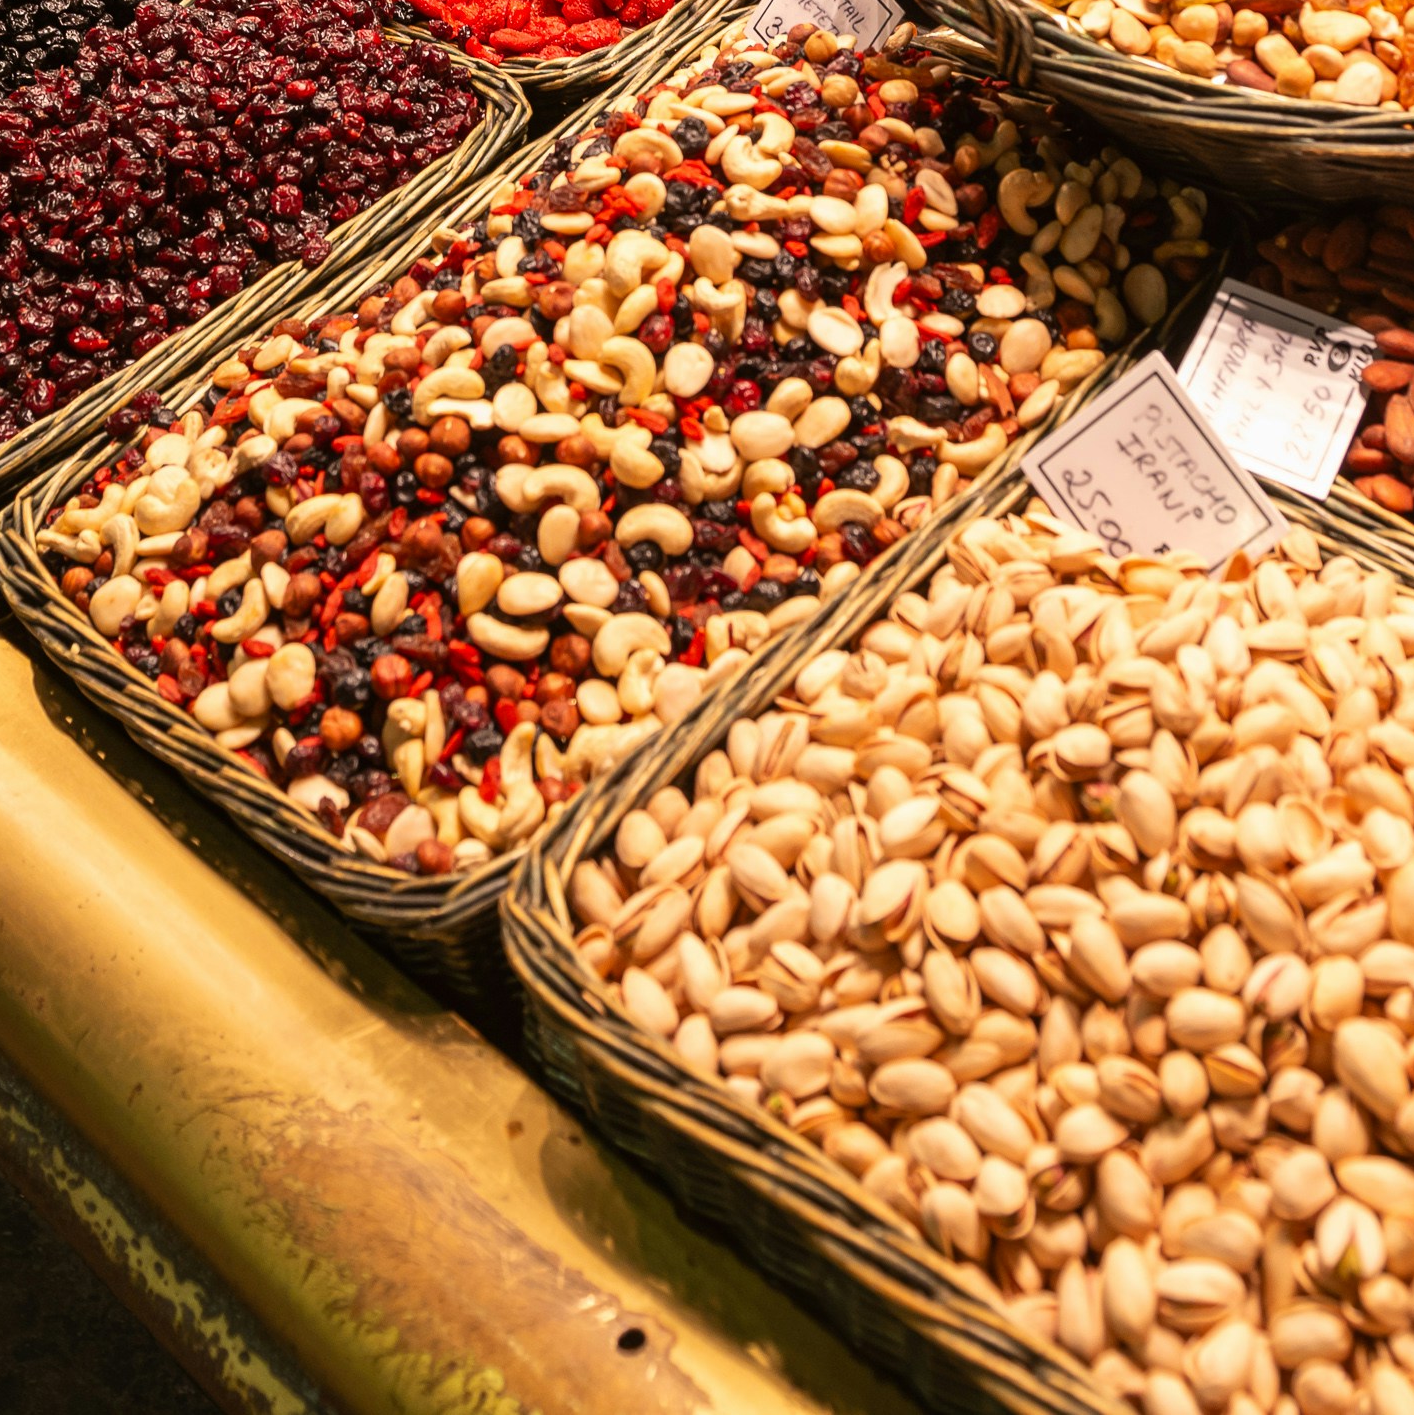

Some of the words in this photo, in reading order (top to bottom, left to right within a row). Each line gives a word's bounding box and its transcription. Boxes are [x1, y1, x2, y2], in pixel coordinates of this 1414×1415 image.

[1202, 317, 1260, 420] LMENDRA
[1264, 332, 1293, 376] SAL
[1133, 403, 1237, 525] PISTACHO
